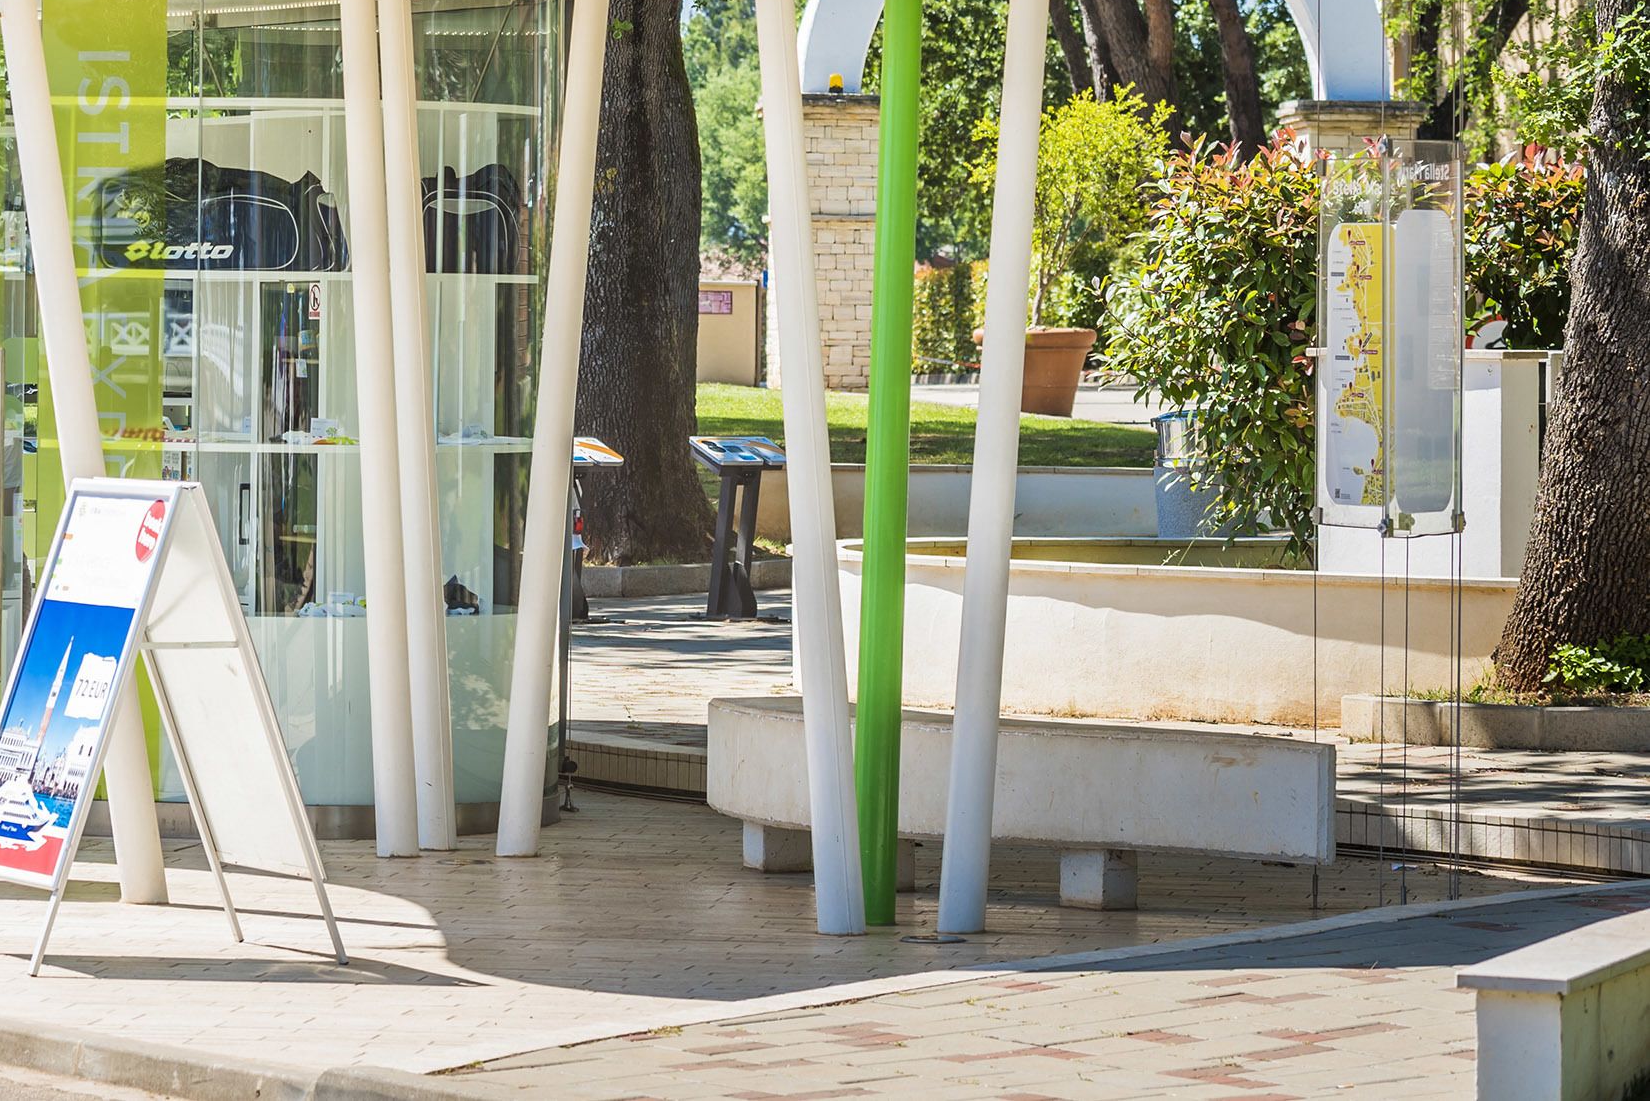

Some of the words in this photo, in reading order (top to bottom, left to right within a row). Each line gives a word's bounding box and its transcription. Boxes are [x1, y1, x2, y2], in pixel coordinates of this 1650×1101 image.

[149, 242, 234, 260] lotto
[76, 678, 90, 697] 72
[88, 680, 109, 699] EUR
